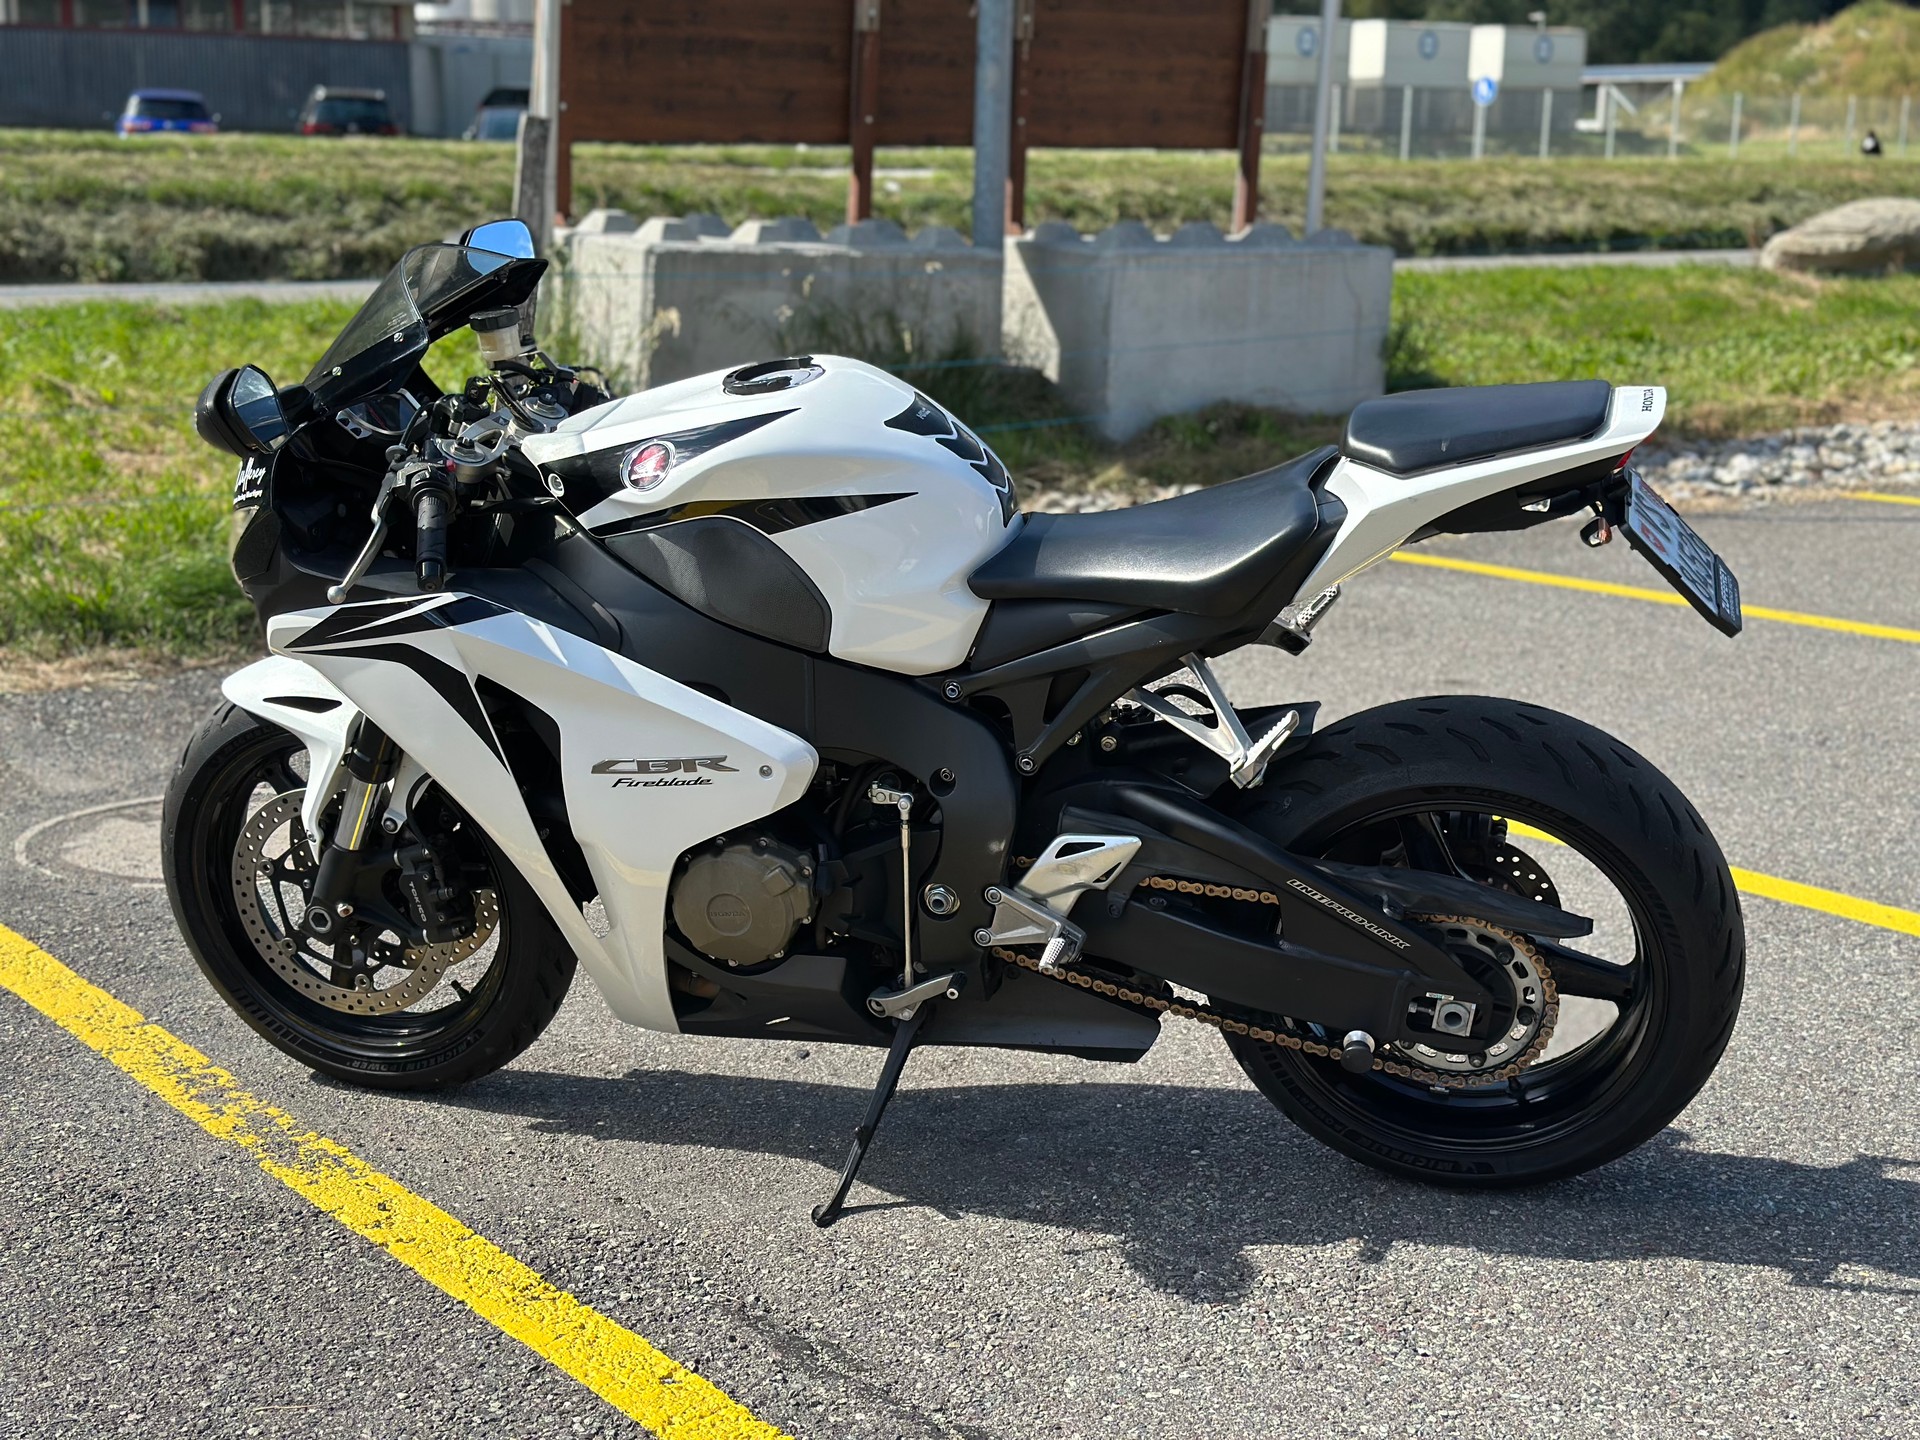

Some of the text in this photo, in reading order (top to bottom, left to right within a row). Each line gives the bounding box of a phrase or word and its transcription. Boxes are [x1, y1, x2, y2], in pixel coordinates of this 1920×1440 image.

[1641, 388, 1654, 412] HONDA
[1634, 492, 1671, 543] VS
[591, 755, 740, 774] CBR
[611, 777, 714, 788] Fireblade
[409, 881, 427, 922] TOKICO
[710, 910, 746, 918] HONDA
[1286, 879, 1411, 950] UNIT PRO-LINK
